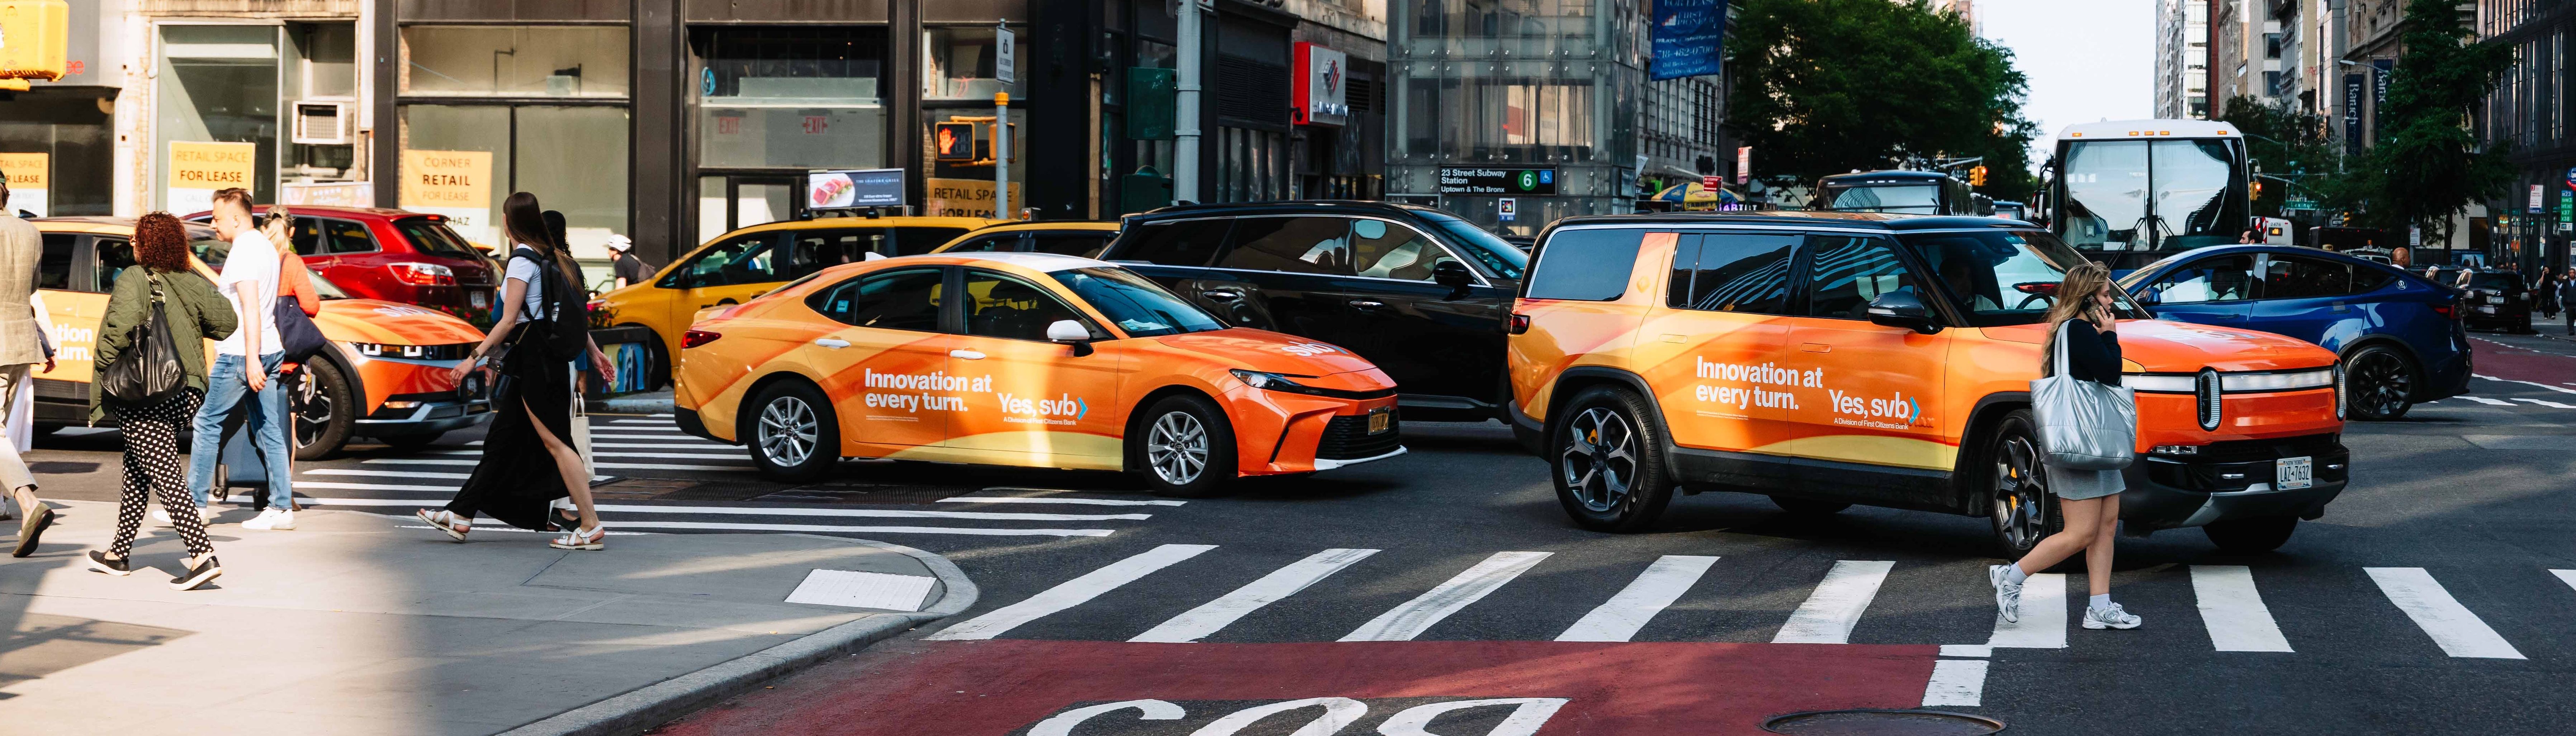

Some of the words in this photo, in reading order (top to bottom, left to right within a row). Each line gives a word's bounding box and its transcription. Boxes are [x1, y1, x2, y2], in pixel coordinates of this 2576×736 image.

[1657, 46, 1713, 58] 718-482-0700
[2349, 84, 2359, 124] Baruch
[719, 117, 739, 134] EXIT
[805, 116, 826, 134] EXIT
[176, 151, 211, 161] RETAIL
[214, 152, 247, 162] SPACE
[425, 158, 470, 167] CORNER
[14, 175, 39, 183] LEASE
[180, 170, 203, 180] FOR
[207, 171, 242, 182] LEASE
[423, 175, 470, 185] RETAIL
[1477, 169, 1506, 178] Subway
[1523, 174, 1532, 187] 6
[423, 191, 441, 199] FOR
[443, 192, 469, 200] LEASE
[934, 188, 972, 200] RETAIL
[939, 208, 964, 217] FOR
[57, 346, 93, 360] urn.
[1281, 341, 1335, 356] svb
[1697, 356, 1799, 386] Innovation
[1803, 367, 1823, 388] at
[865, 368, 968, 391] Innovation
[971, 374, 992, 392] at
[865, 393, 919, 412] every
[922, 392, 968, 411] turn.
[1696, 384, 1751, 410] every
[1754, 386, 1799, 410] turn.
[1829, 389, 1868, 419] Yes,
[1871, 392, 1909, 419] svb
[997, 393, 1037, 417] Yes,
[1039, 393, 1076, 416] svb
[2280, 466, 2291, 482] LAZ
[2295, 465, 2309, 481] 7632
